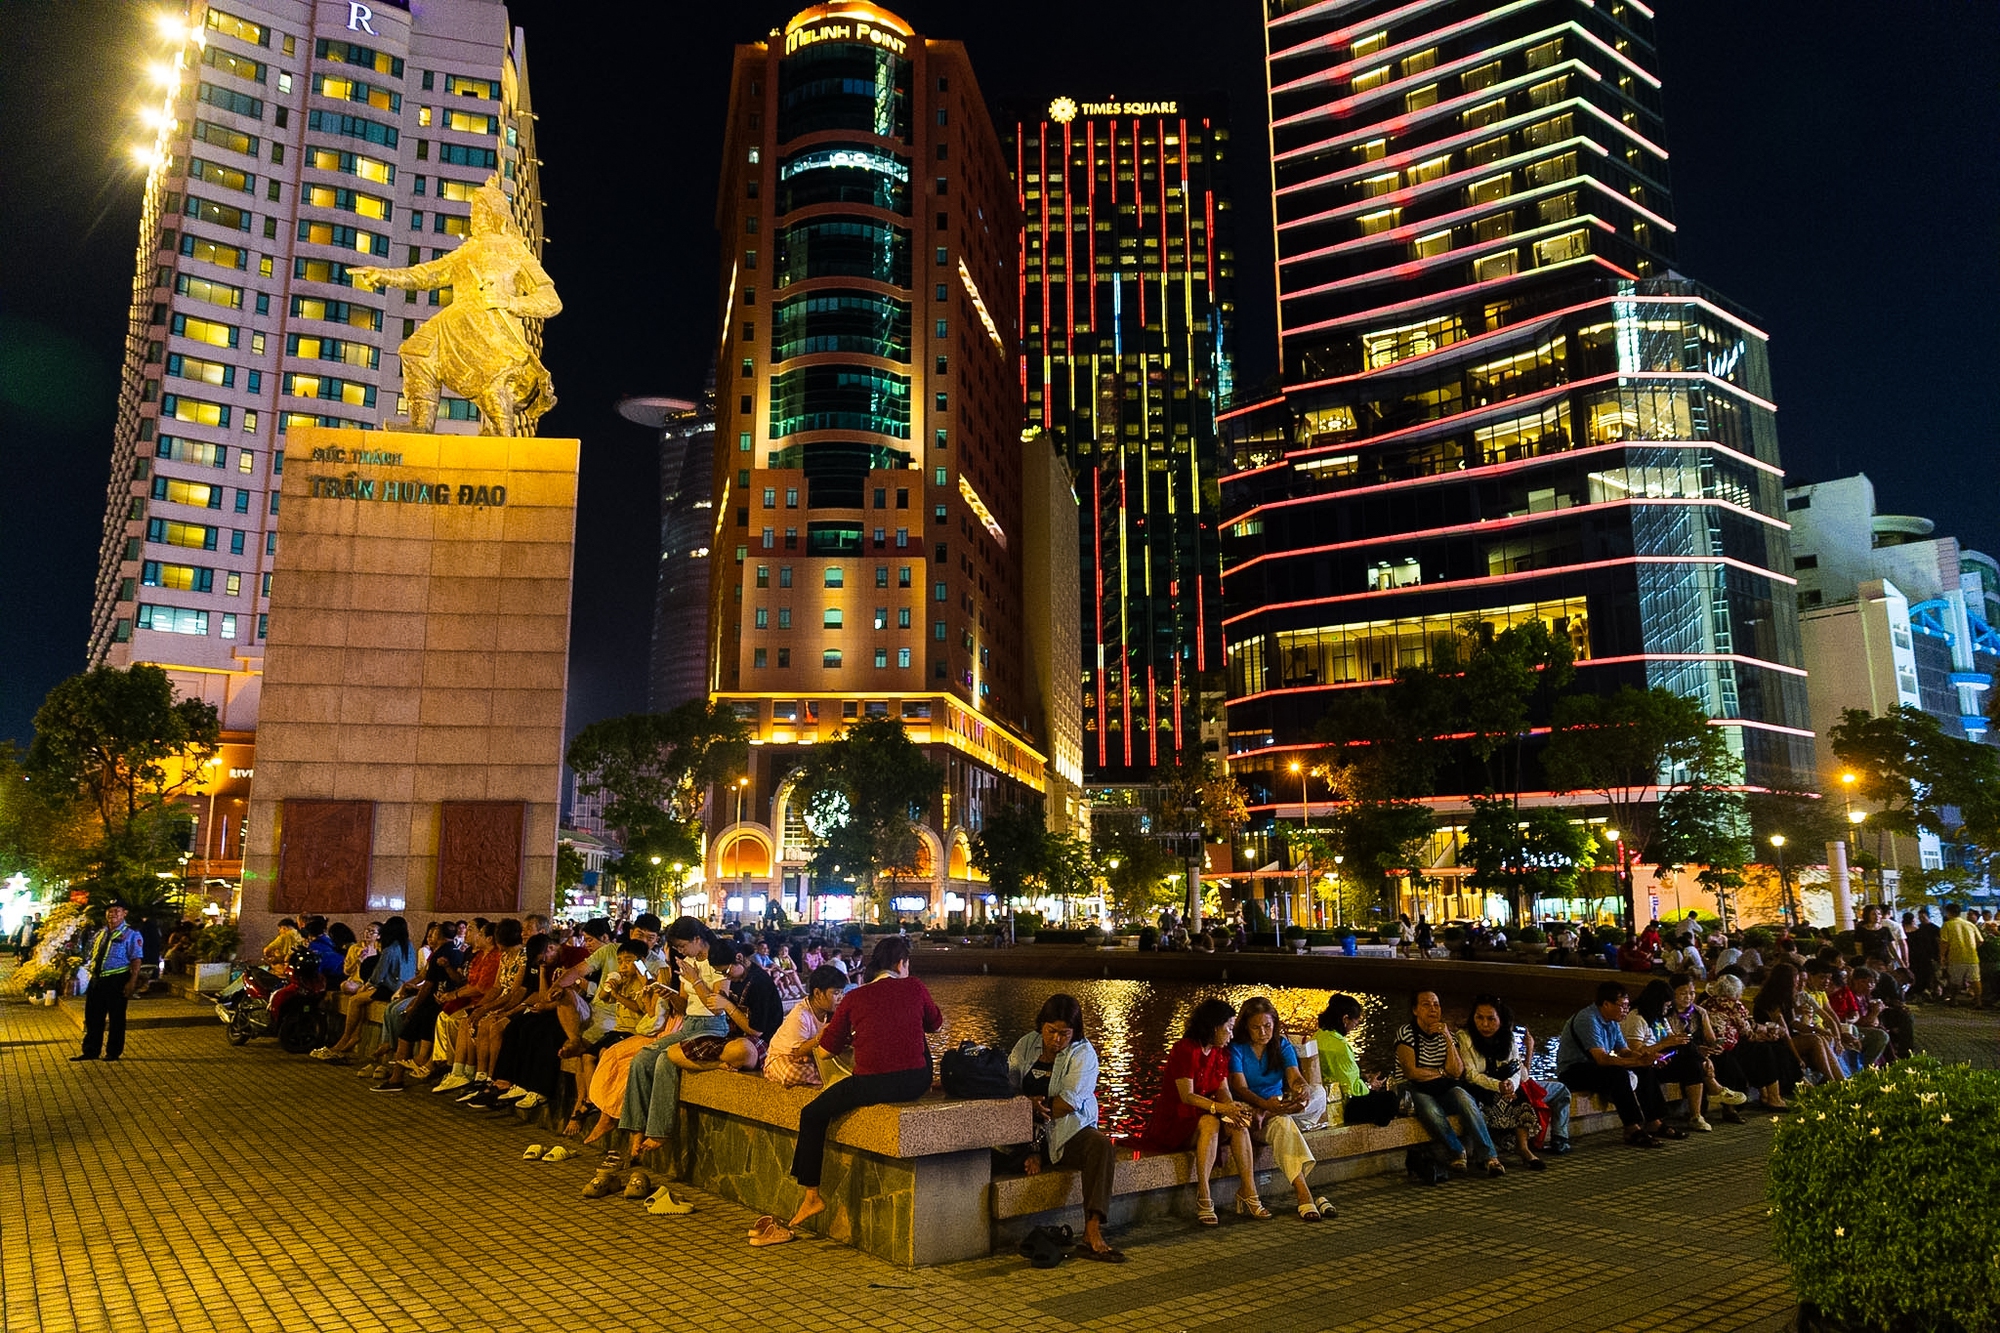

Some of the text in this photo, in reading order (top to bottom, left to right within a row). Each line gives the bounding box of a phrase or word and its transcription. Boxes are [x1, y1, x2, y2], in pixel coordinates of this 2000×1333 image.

[346, 1, 379, 36] R
[856, 23, 907, 54] POINT
[1081, 101, 1177, 115] TIMES SQUARE
